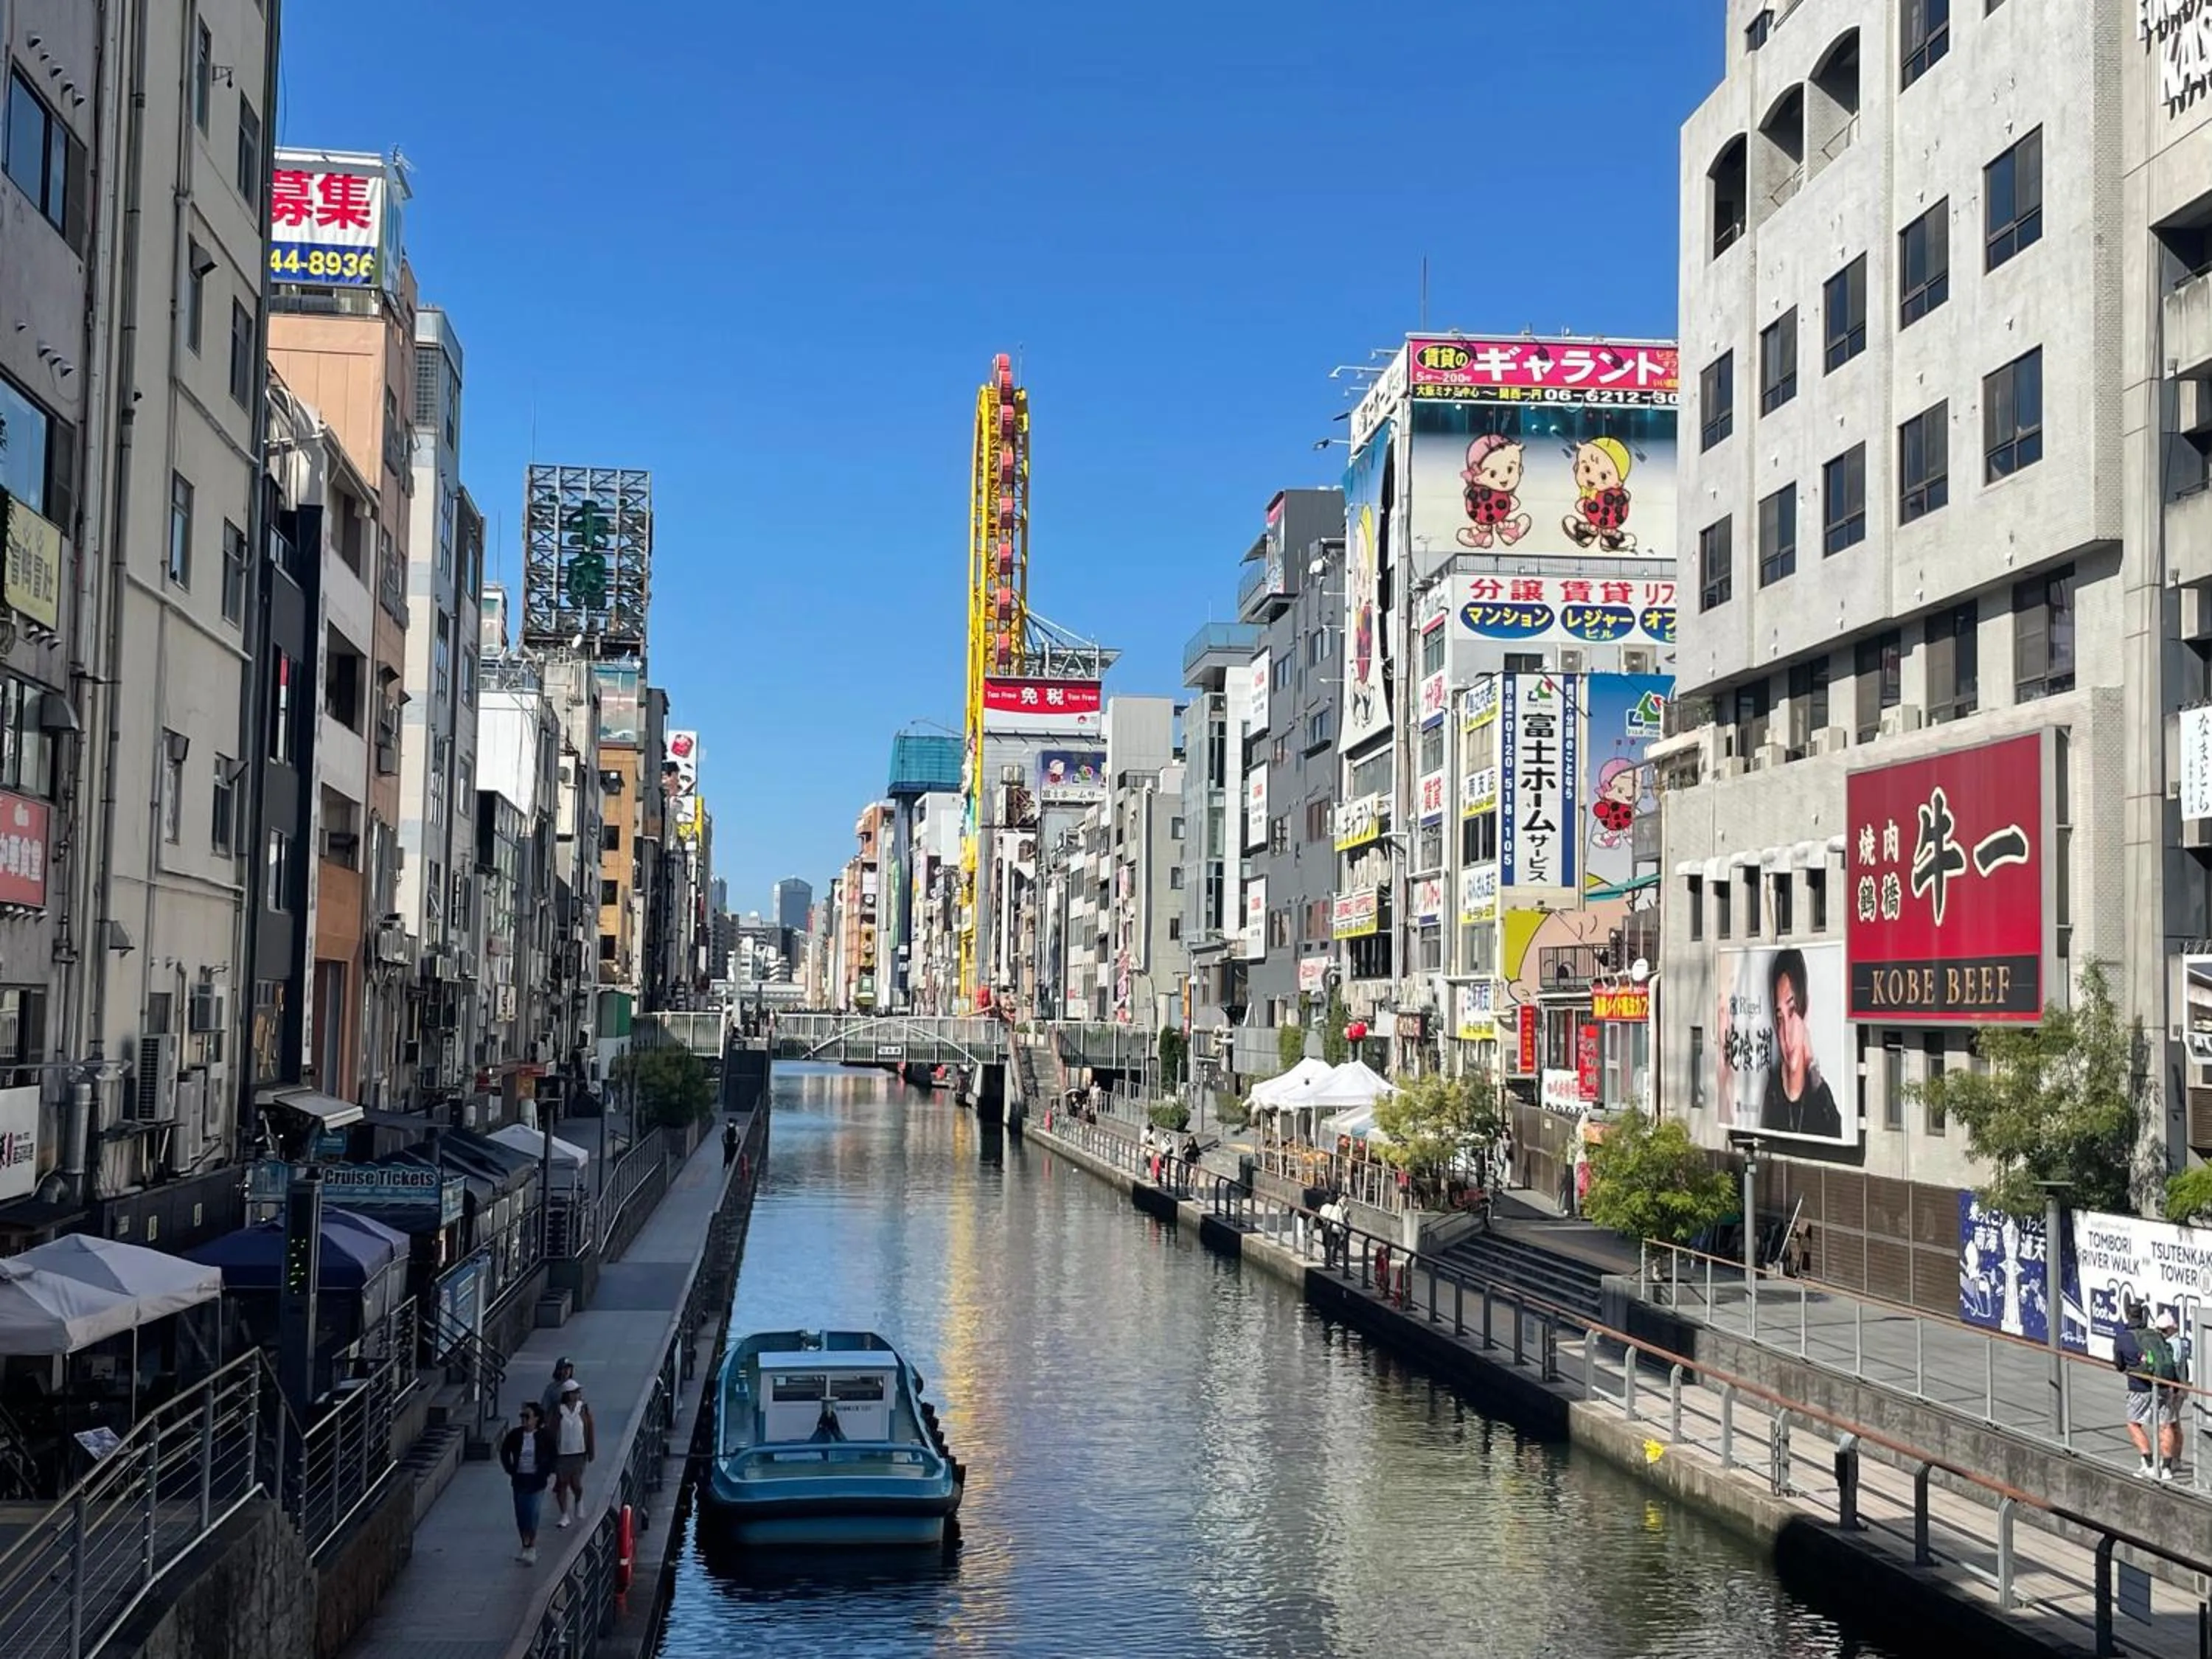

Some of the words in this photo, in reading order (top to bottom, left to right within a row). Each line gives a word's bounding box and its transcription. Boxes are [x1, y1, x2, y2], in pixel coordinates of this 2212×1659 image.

[272, 169, 371, 230] 募集
[1474, 346, 1666, 386] ギャラント
[1470, 579, 1544, 601] 分譲
[1559, 580, 1633, 604] 賃貸
[1467, 607, 1551, 627] マンション
[1567, 609, 1633, 628] レジャー
[1020, 686, 1064, 706] 免税
[1520, 712, 1557, 883] 富士ホームサービス
[1857, 818, 1900, 867] 焼肉
[1911, 785, 2030, 928] 牛一
[1857, 871, 1902, 923] 鶴橋
[1871, 969, 1935, 1006] KOBE
[1946, 965, 2011, 1005] BEEF
[324, 1170, 374, 1185] Cruise
[380, 1170, 434, 1186] Tickets
[2088, 1231, 2131, 1254] TOMBORI
[2111, 1254, 2140, 1276] WALK
[2160, 1263, 2198, 1287] TOWER
